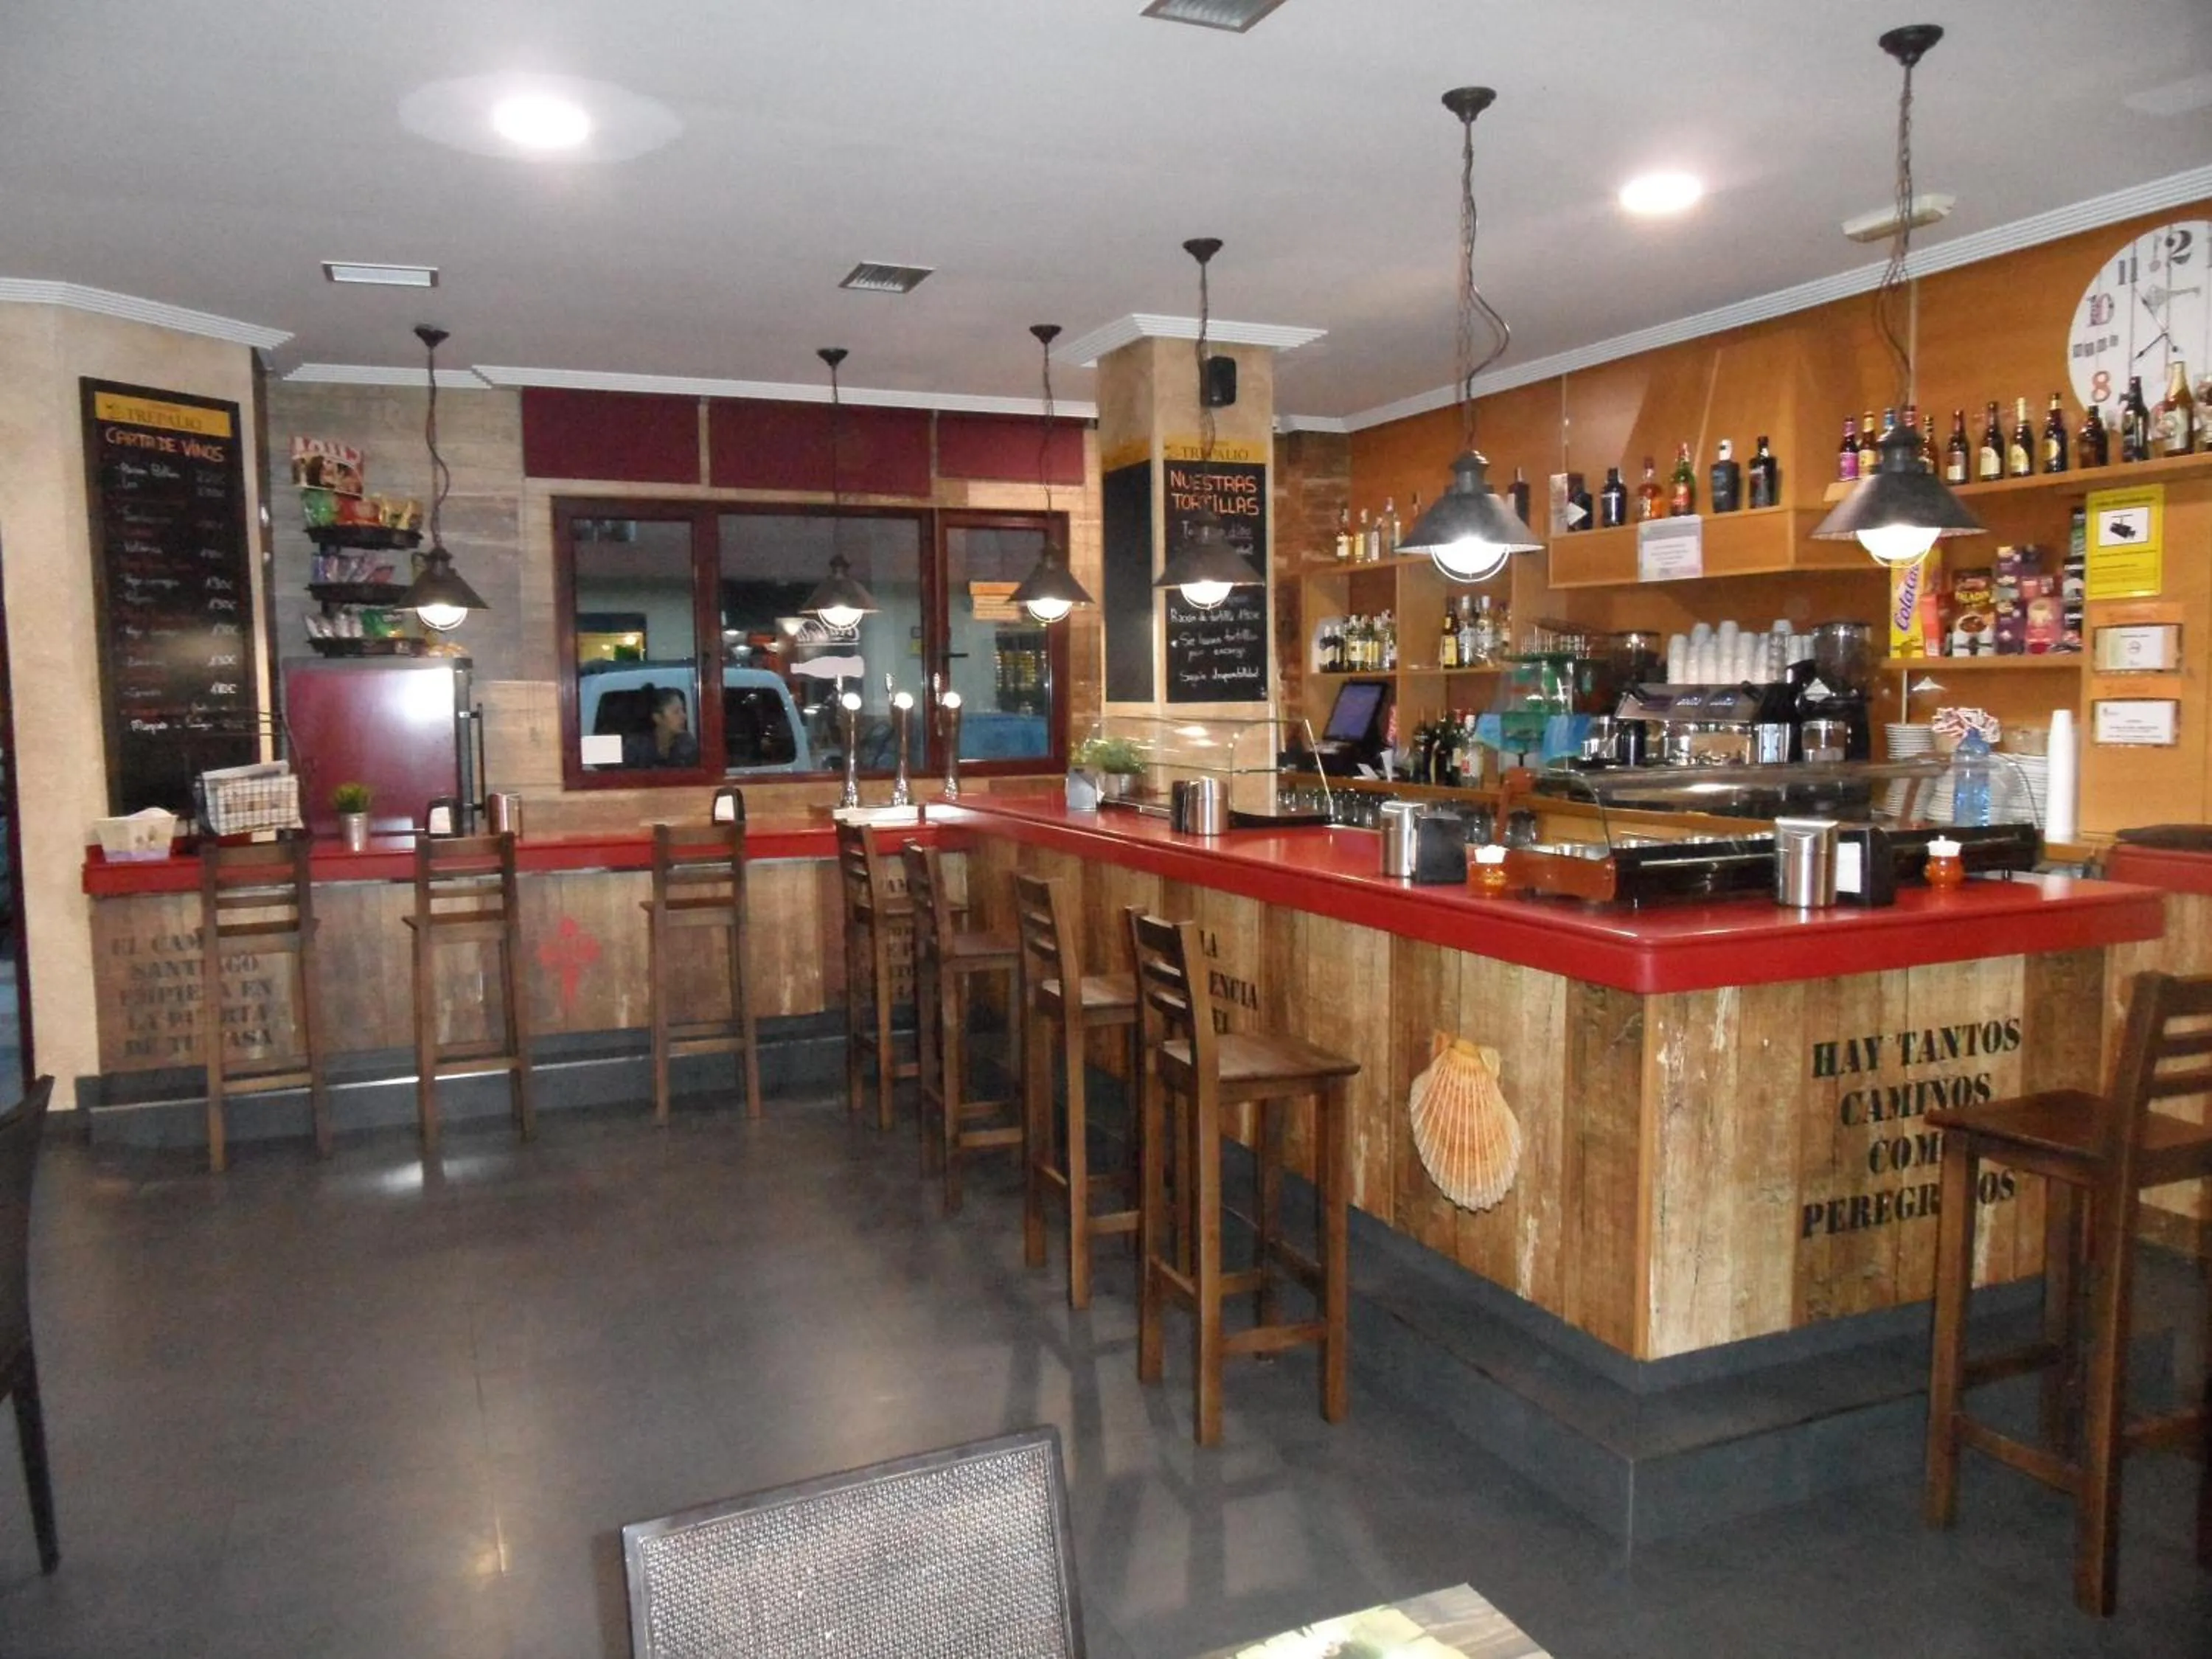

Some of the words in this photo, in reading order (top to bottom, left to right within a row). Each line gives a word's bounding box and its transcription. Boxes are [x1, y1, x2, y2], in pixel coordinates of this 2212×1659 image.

[2092, 371, 2111, 403] 8
[1170, 470, 1257, 494] NUESTRAS
[1171, 493, 1259, 516] TORTILLAS
[1812, 1035, 1883, 1078] HAY
[1897, 1017, 2021, 1067] TANTOS
[1840, 1072, 1992, 1127] CAMINOS
[1868, 1130, 1944, 1175] COM
[1802, 1168, 2016, 1239] PEREGROS
